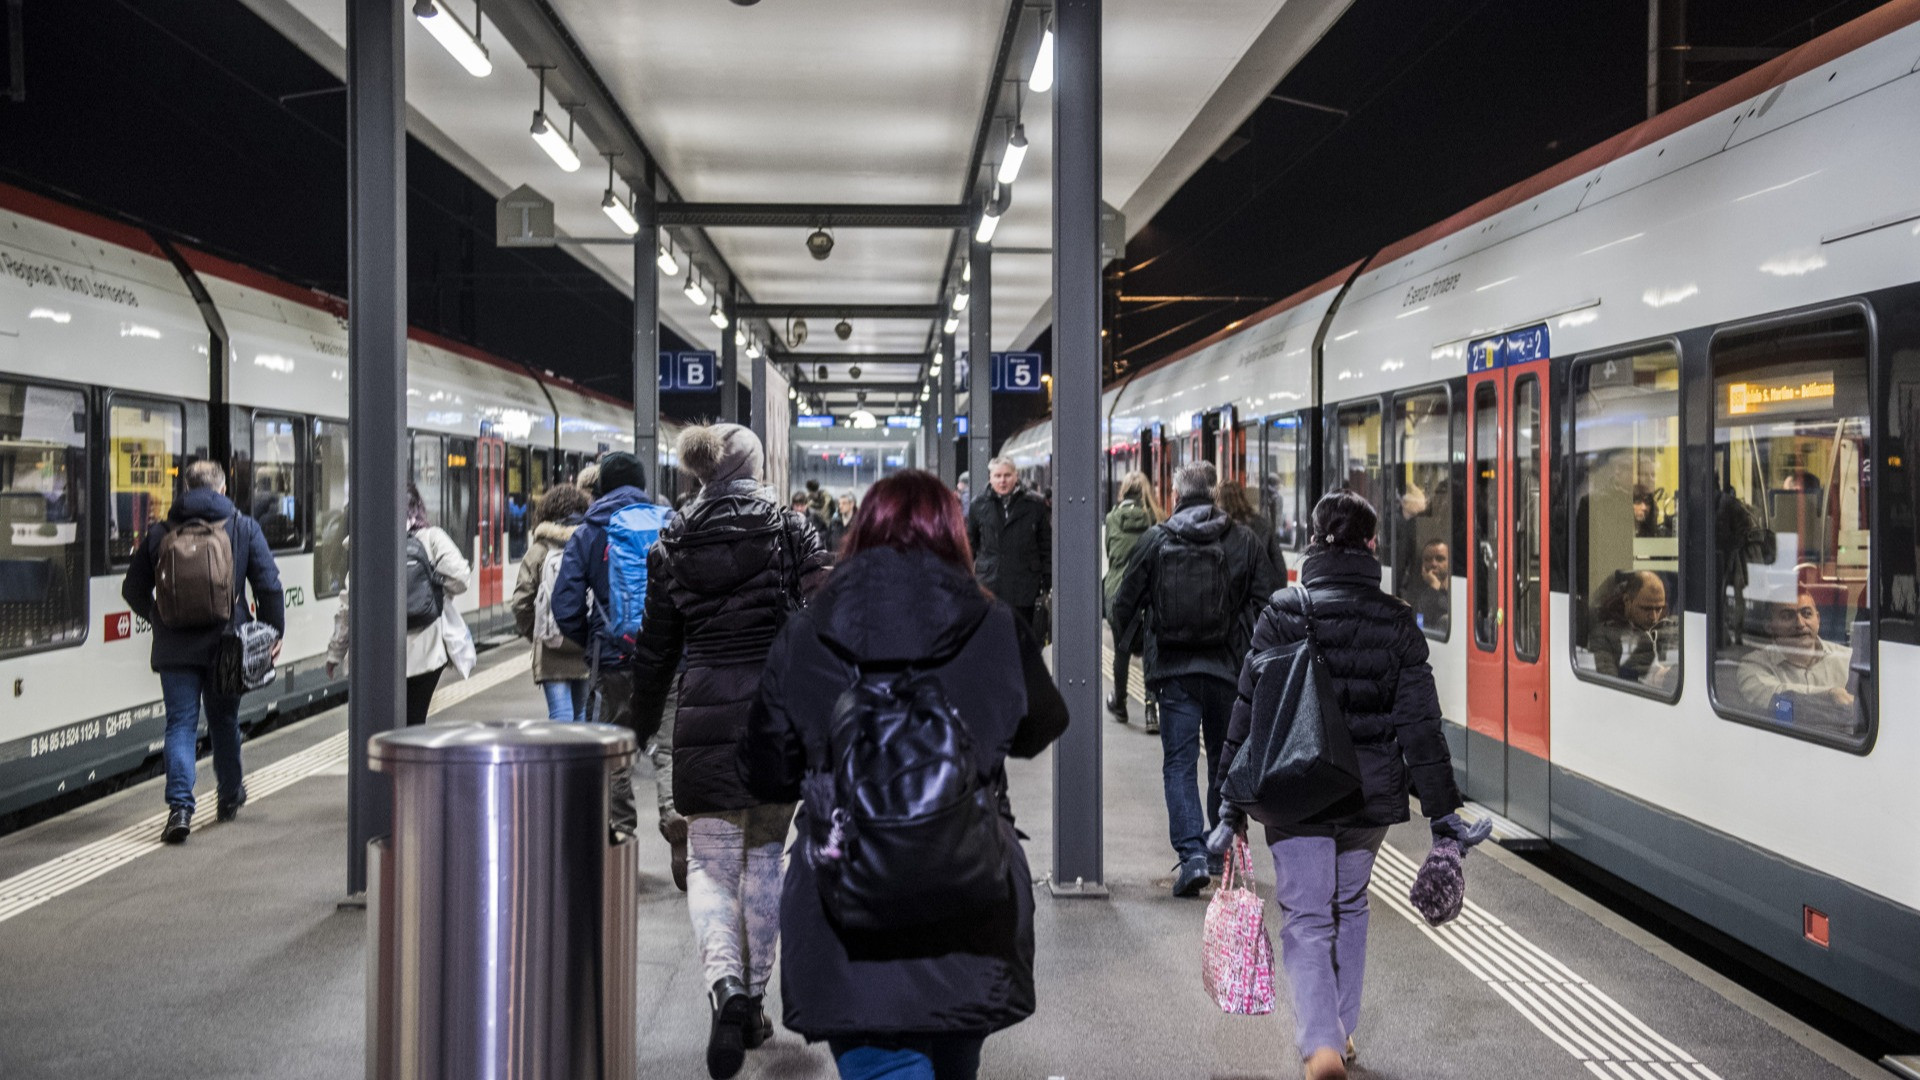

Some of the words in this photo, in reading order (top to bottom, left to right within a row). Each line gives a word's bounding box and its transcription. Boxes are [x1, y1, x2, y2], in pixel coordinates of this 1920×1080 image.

[52, 265, 89, 295] Ticino
[85, 275, 139, 307] Lombardia
[1534, 329, 1542, 359] 2
[1472, 345, 1479, 372] 2
[687, 363, 704, 385] B
[1014, 364, 1031, 386] 5
[30, 737, 38, 758] B
[39, 736, 48, 755] 94
[49, 732, 59, 753] 85
[60, 730, 66, 749] 3
[66, 726, 79, 747] 524
[105, 710, 132, 735] CH-FFS
